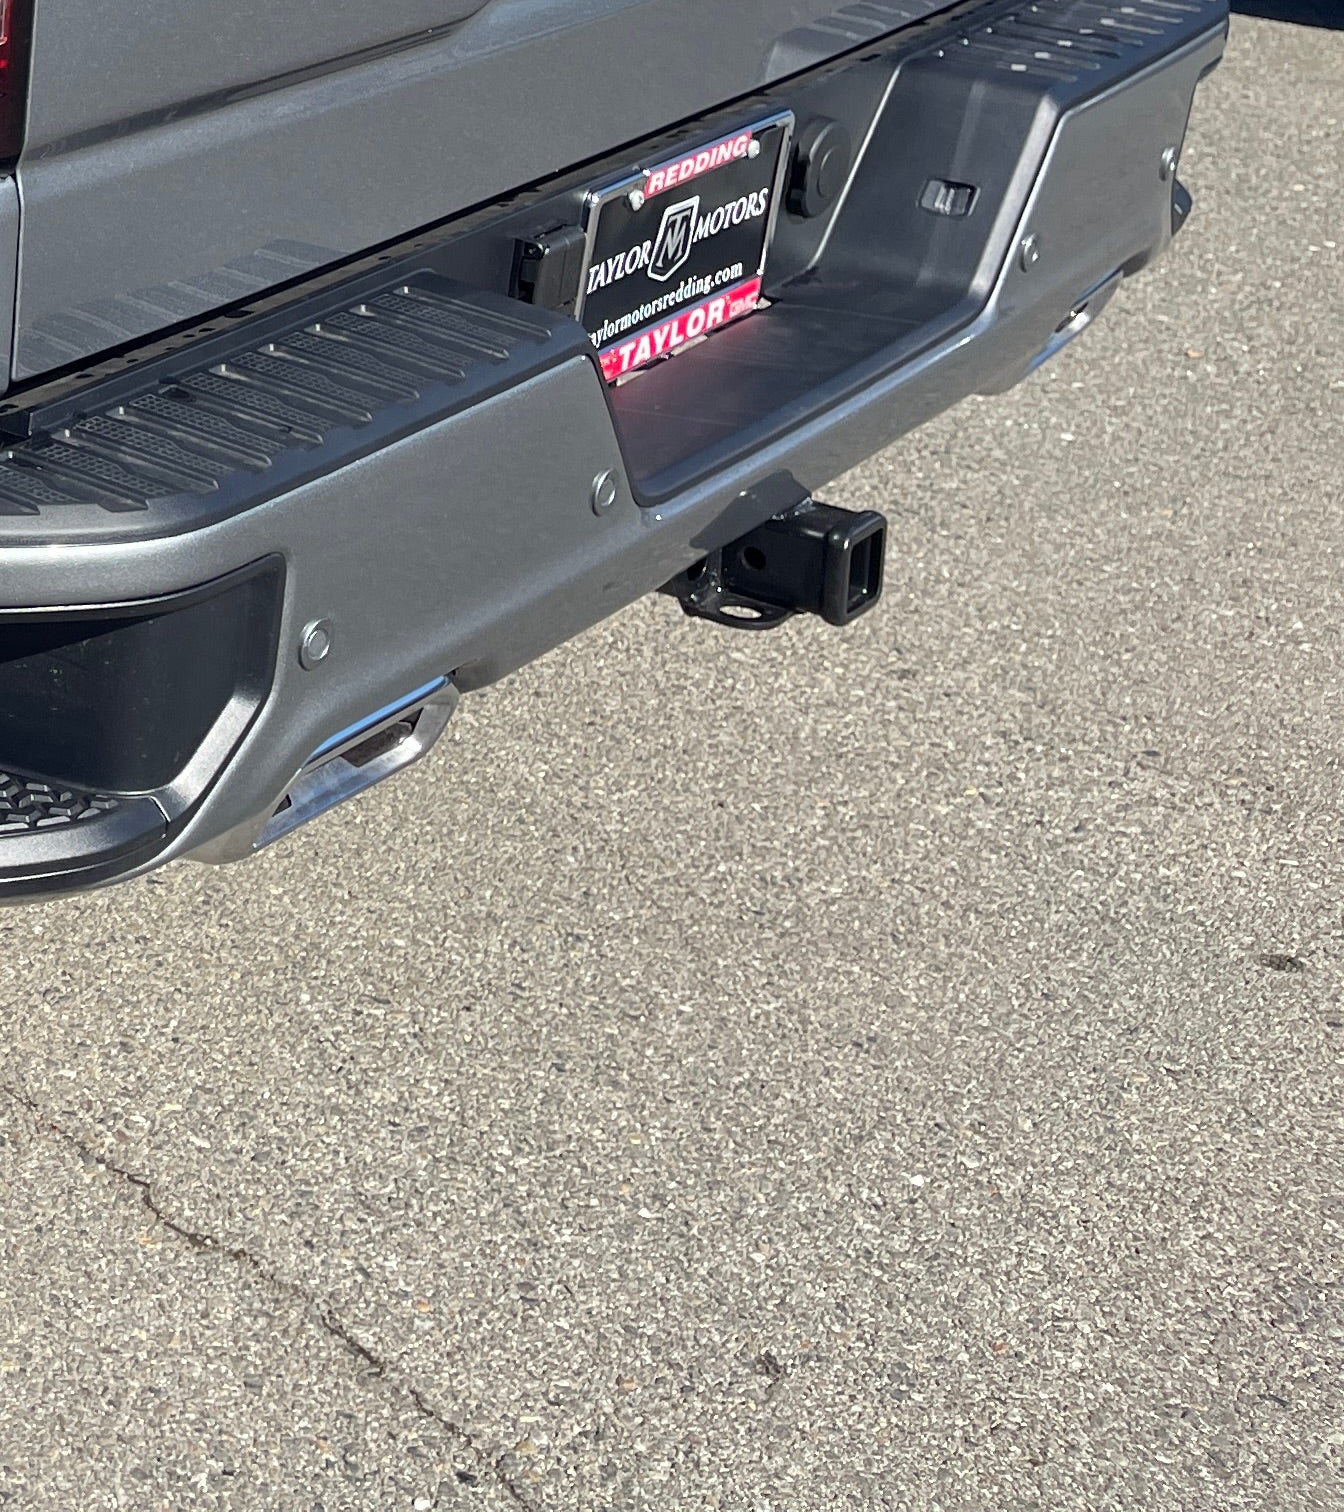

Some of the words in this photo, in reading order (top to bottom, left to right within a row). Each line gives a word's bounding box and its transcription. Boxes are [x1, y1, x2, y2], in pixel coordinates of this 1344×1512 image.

[648, 135, 748, 194] REDDING
[587, 240, 652, 295] TAYLOR
[693, 188, 769, 243] MOTORS
[619, 297, 726, 371] TAYLOR
